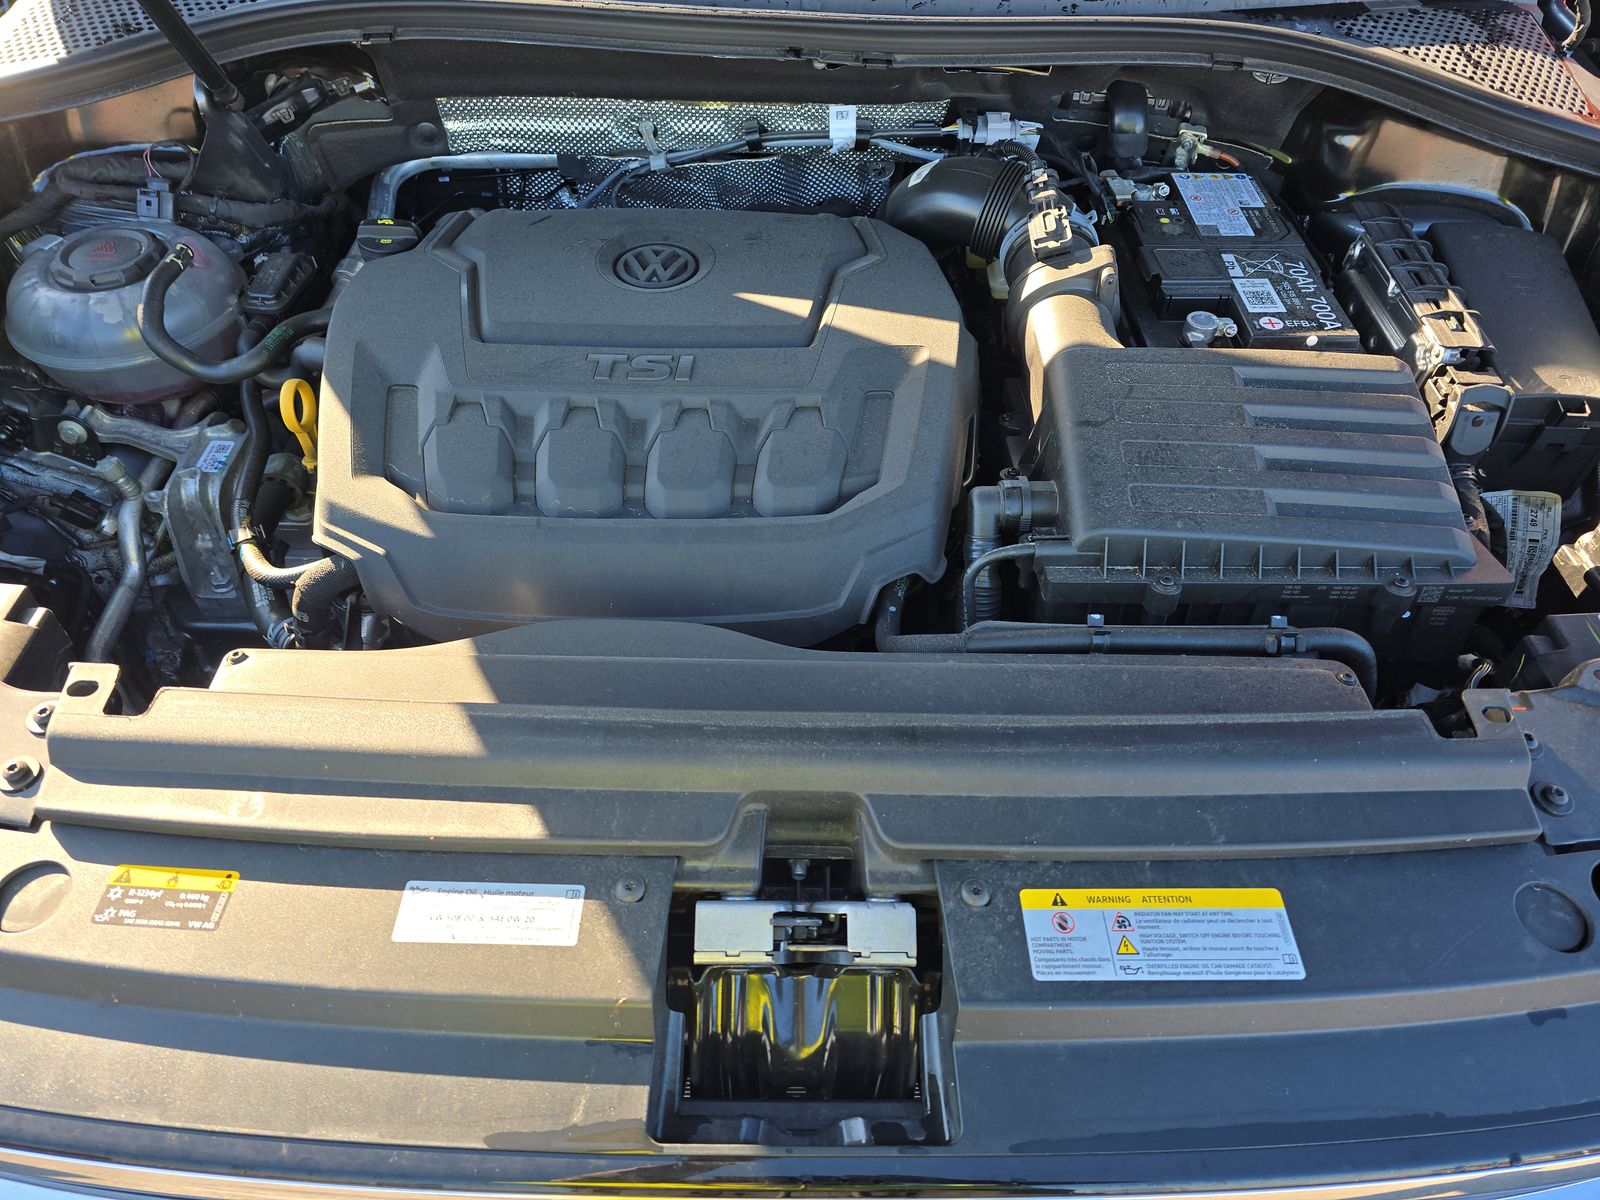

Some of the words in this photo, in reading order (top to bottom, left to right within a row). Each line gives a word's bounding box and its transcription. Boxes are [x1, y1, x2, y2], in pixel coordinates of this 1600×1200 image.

[1225, 261, 1235, 270] Pb
[1285, 262, 1317, 292] 70Ah
[1306, 296, 1342, 330] 700A
[585, 353, 696, 380] TSI
[118, 909, 137, 917] PAG
